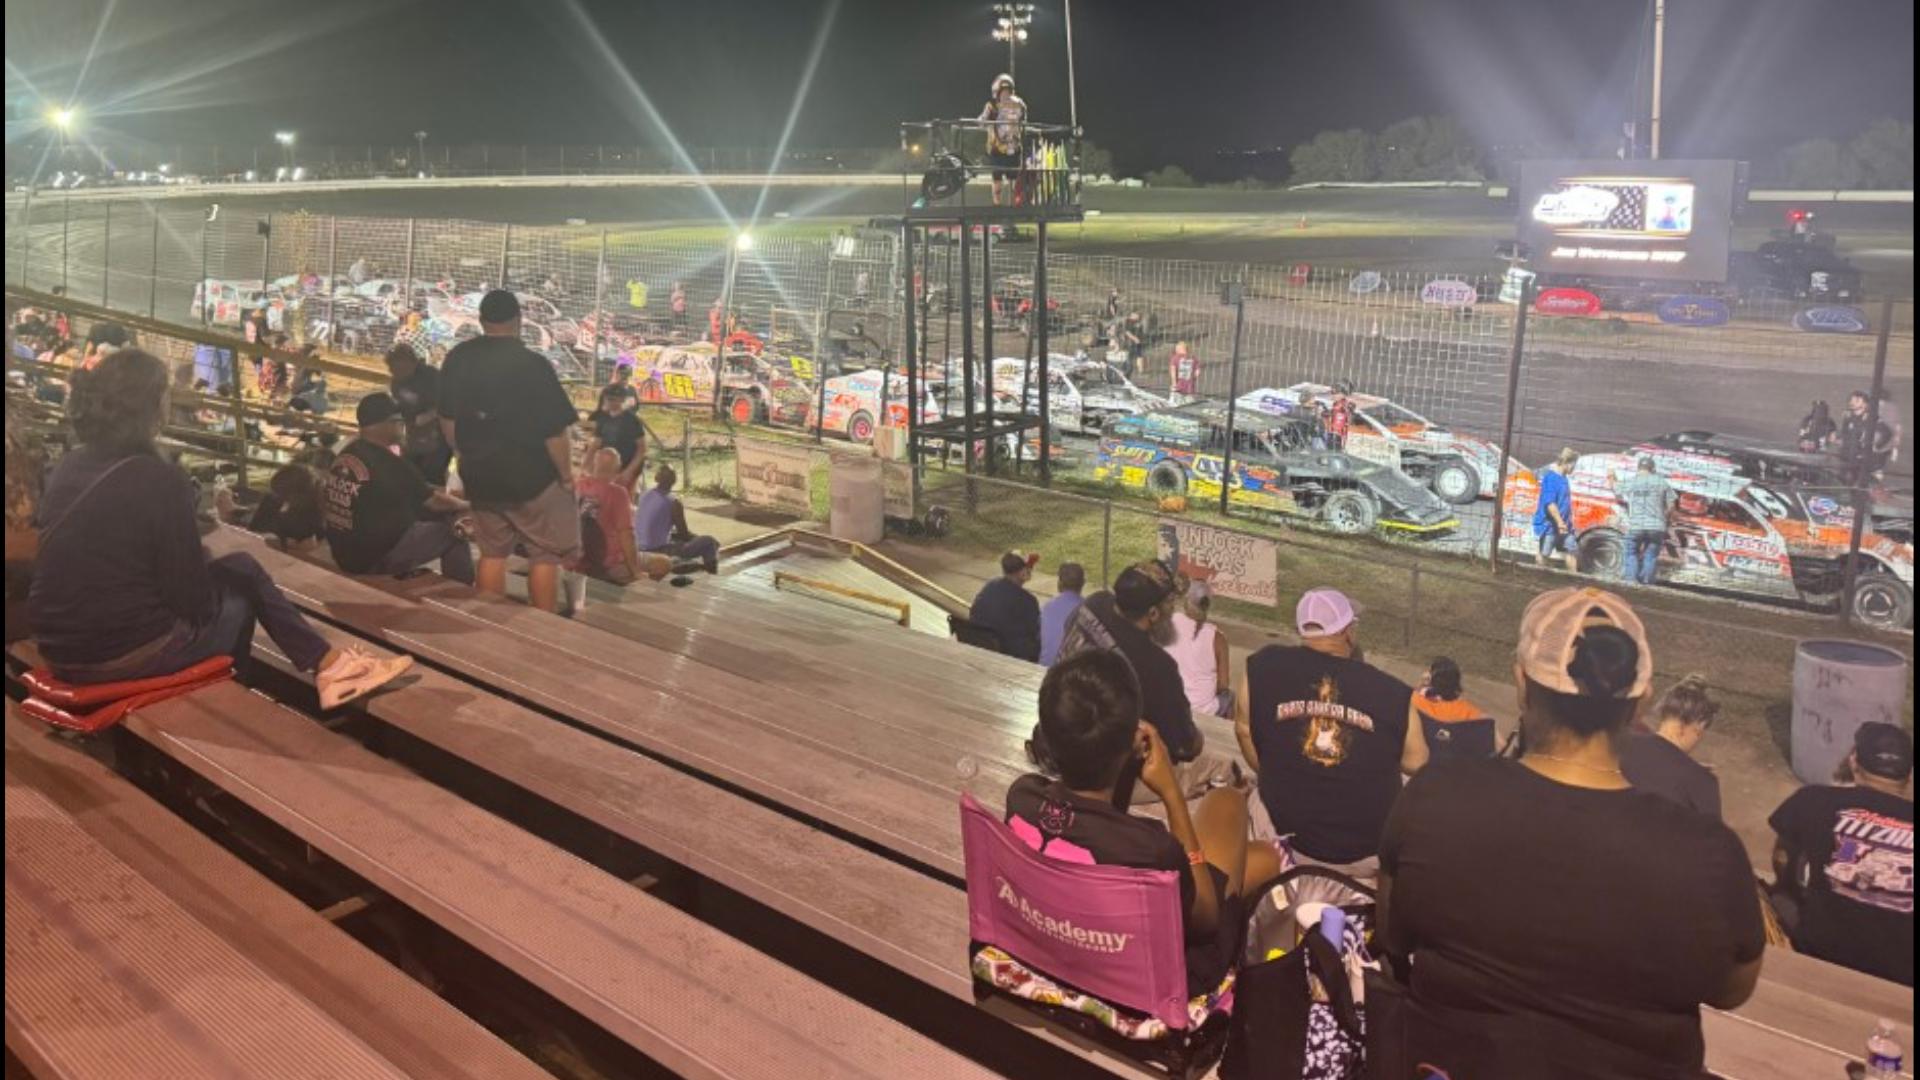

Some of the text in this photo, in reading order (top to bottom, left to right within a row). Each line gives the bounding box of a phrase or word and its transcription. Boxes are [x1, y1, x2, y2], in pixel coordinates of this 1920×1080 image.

[1177, 524, 1254, 561] UNLOCK
[1184, 545, 1246, 577] TEXAS
[1020, 896, 1128, 952] Academy
